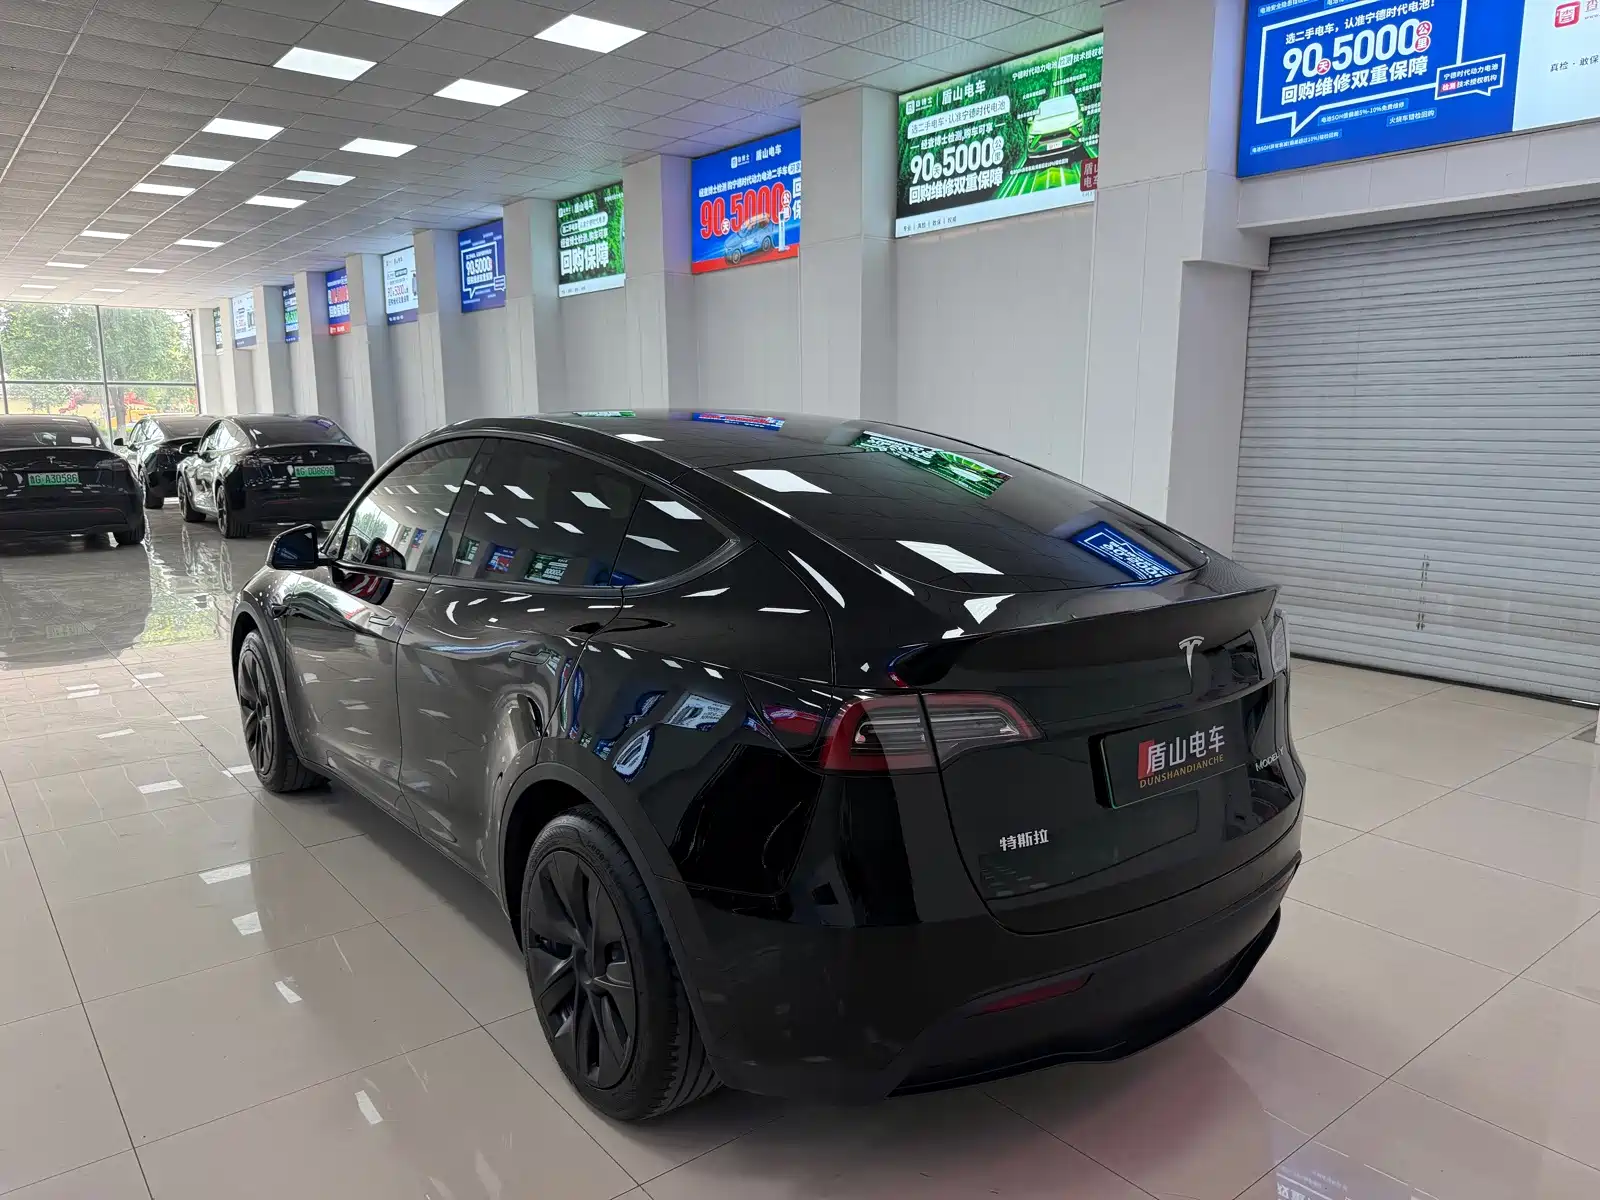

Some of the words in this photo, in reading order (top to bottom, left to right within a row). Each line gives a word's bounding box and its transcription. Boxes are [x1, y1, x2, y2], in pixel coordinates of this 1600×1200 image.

[1281, 56, 1428, 105] 回购维修双重保障
[1443, 63, 1498, 80] 宁德时代动力电池
[942, 79, 986, 105] 盾山电车
[909, 167, 1003, 205] 回购维修双重保障
[560, 240, 609, 276] 回购保障
[1146, 725, 1225, 774] 盾山电车
[1139, 753, 1224, 789] DUNSHANDIANCHE
[999, 828, 1049, 851] 特斯拉
